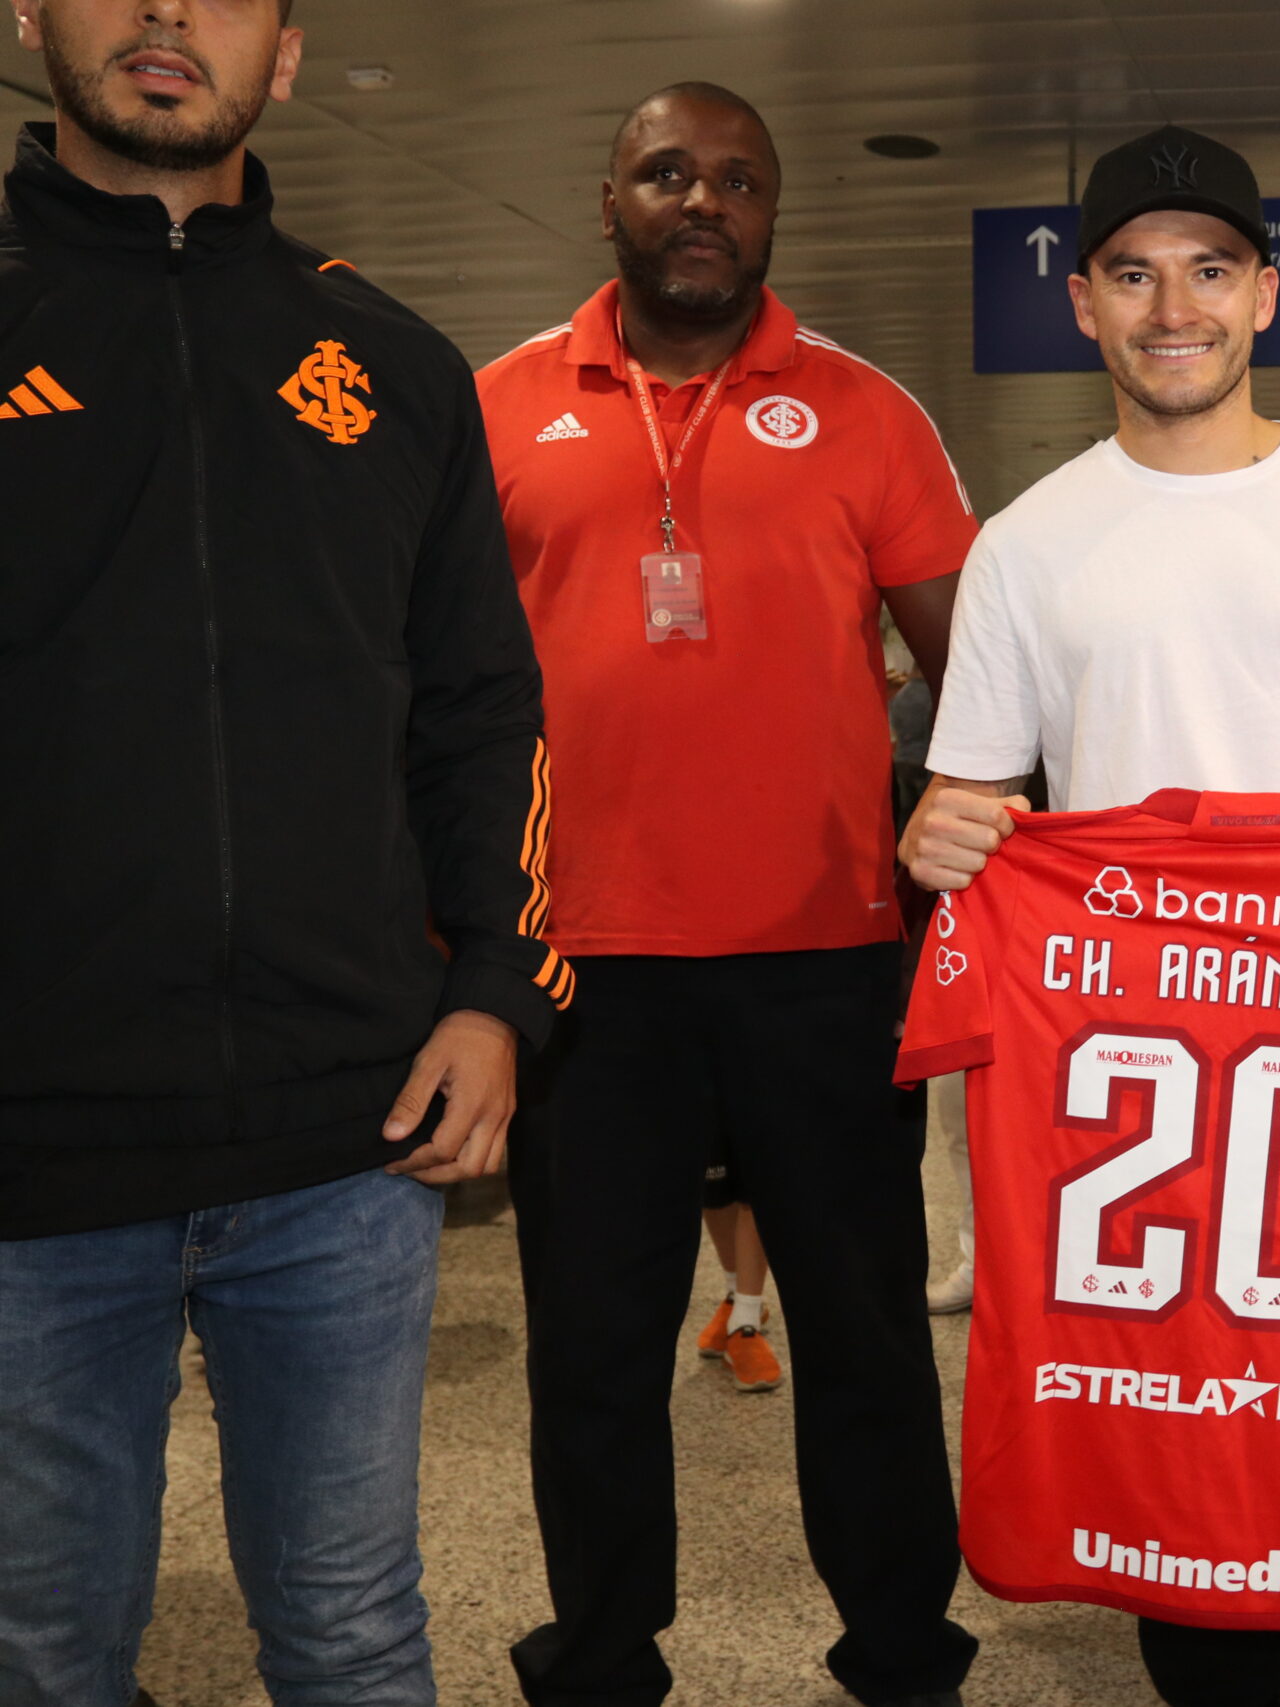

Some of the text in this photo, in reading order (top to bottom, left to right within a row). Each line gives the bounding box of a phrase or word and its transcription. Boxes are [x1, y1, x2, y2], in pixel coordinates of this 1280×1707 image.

[639, 395, 650, 416] CLUB
[692, 405, 708, 426] CLUB
[1042, 934, 1125, 996] CH.
[1096, 1049, 1174, 1067] MARQUESPAN
[1034, 1361, 1229, 1416] ESTRELA
